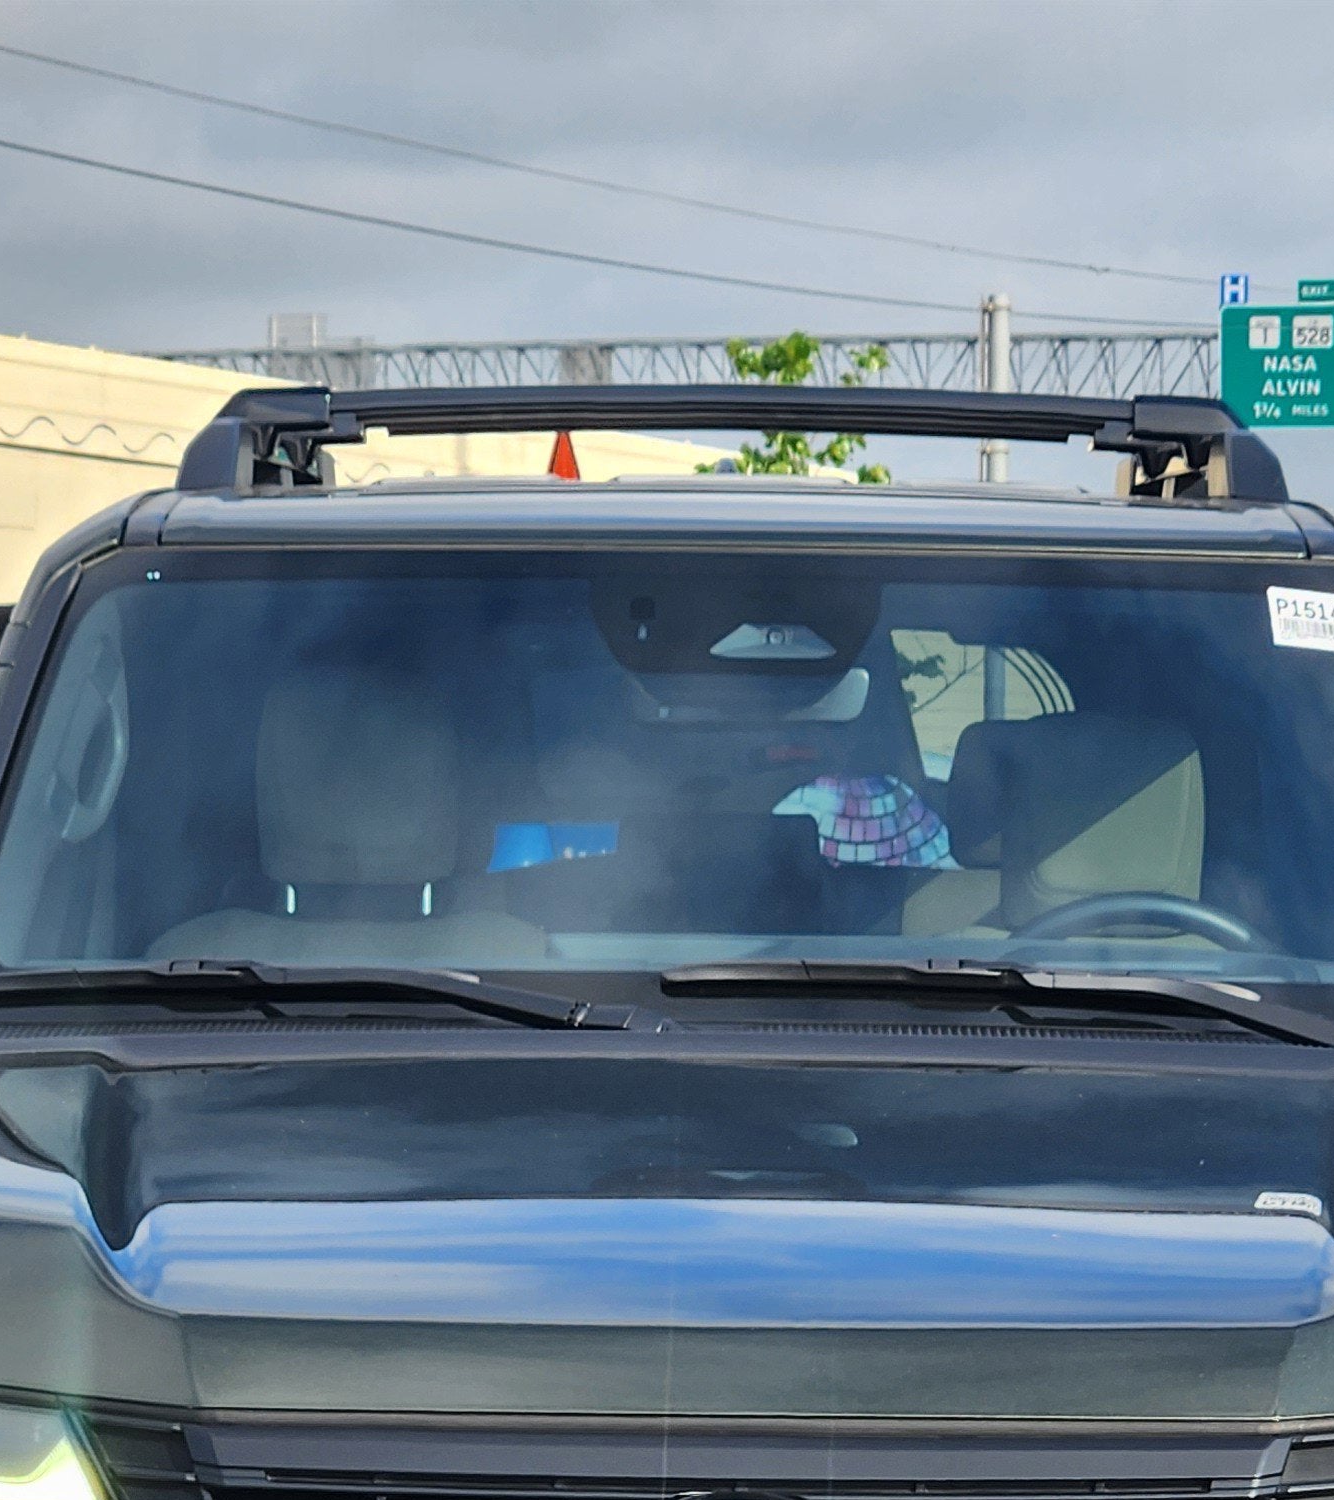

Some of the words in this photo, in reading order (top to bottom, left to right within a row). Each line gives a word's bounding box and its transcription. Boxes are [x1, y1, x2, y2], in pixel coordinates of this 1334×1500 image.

[1300, 285, 1329, 297] EXIT
[1296, 326, 1330, 346] 528
[1263, 354, 1317, 373] NASA
[1262, 378, 1321, 397] ALVIN
[1291, 404, 1330, 417] MILES
